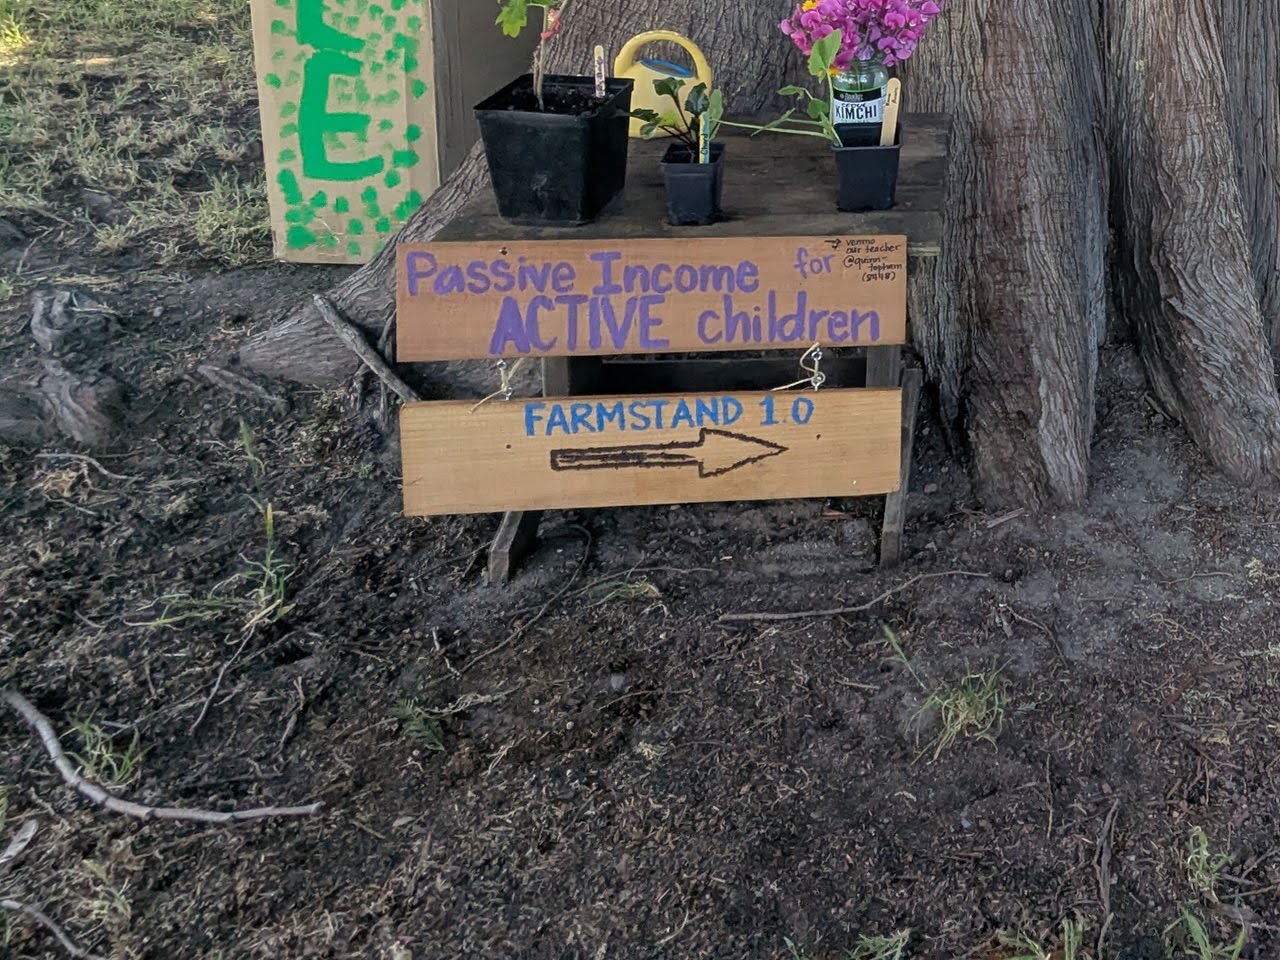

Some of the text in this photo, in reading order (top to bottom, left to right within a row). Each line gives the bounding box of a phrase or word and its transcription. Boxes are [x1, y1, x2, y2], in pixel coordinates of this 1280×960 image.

[835, 104, 877, 120] KIMCHI
[846, 238, 876, 246] venmo
[865, 242, 901, 253] teacher
[405, 247, 837, 296] Passive Income for
[488, 290, 880, 356] ACTIVE children
[524, 394, 815, 437] FARMSTAND 1.0
